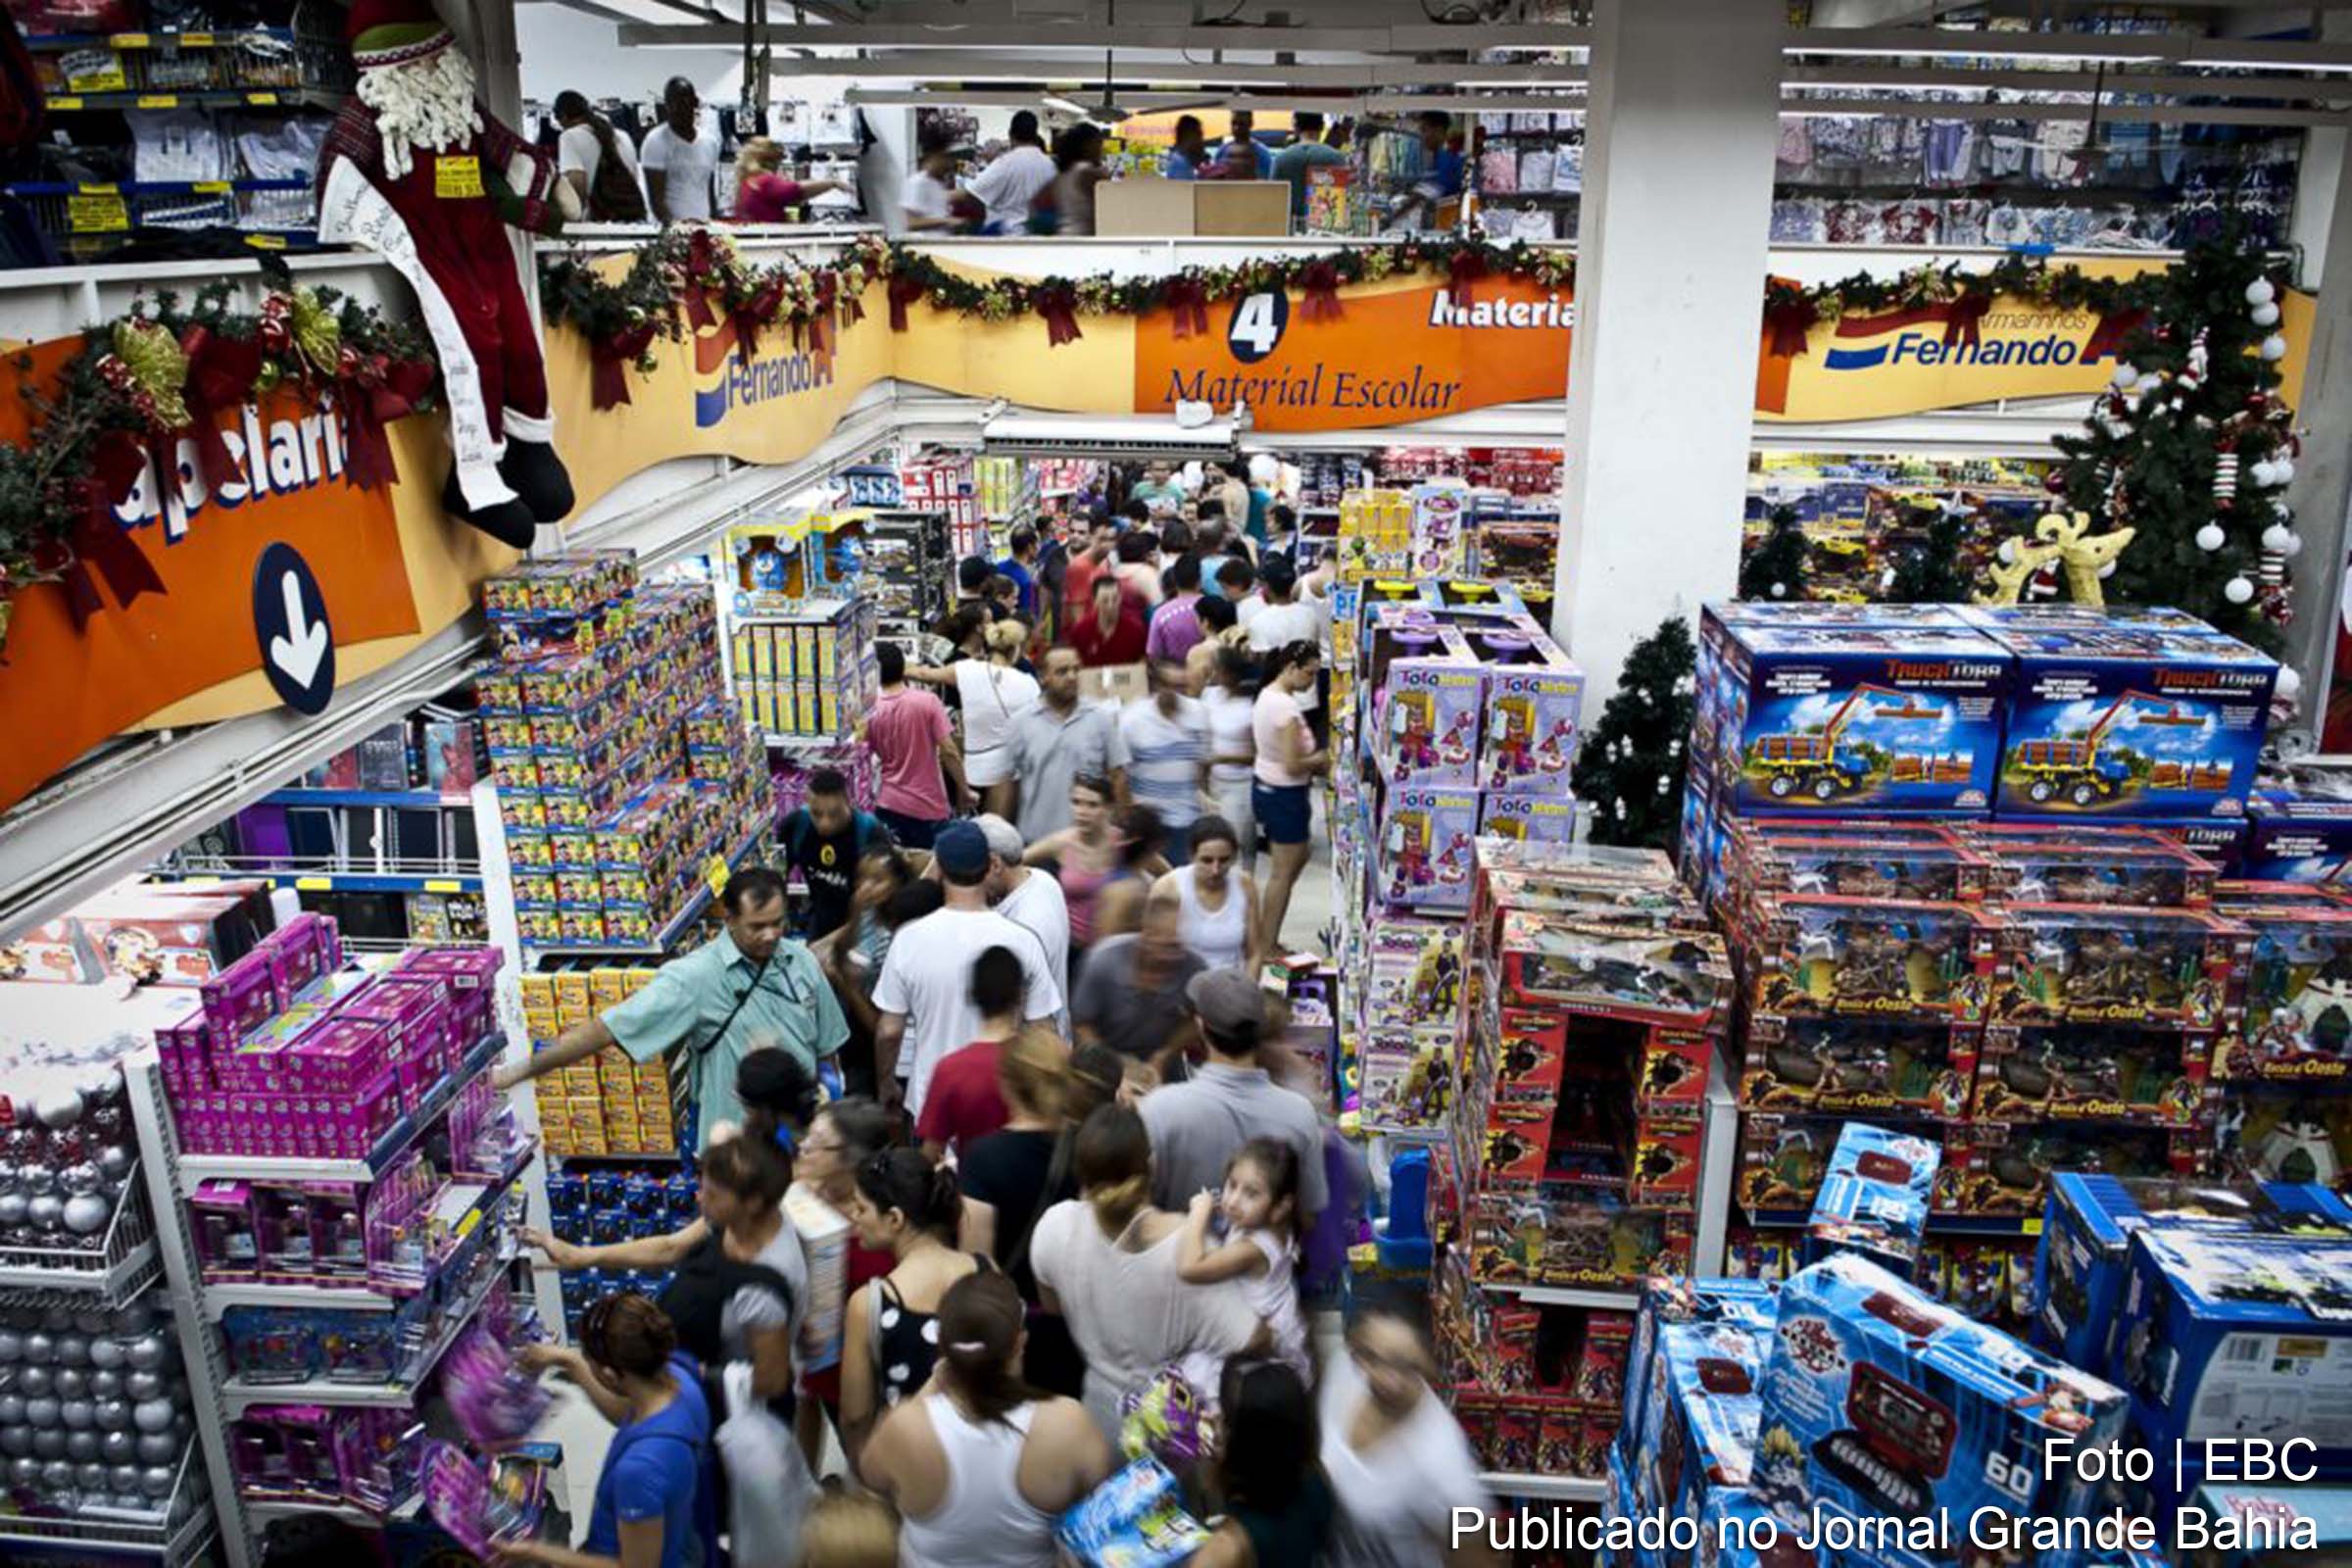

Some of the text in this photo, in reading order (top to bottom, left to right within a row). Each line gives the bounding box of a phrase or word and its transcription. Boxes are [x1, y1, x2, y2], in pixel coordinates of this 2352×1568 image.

[1230, 293, 1278, 353] 4
[1430, 289, 1576, 328] Materia
[1891, 332, 2078, 366] Fernando
[727, 353, 812, 410] Fernando
[1164, 362, 1462, 409] Material Escolar
[111, 391, 349, 545] aplari
